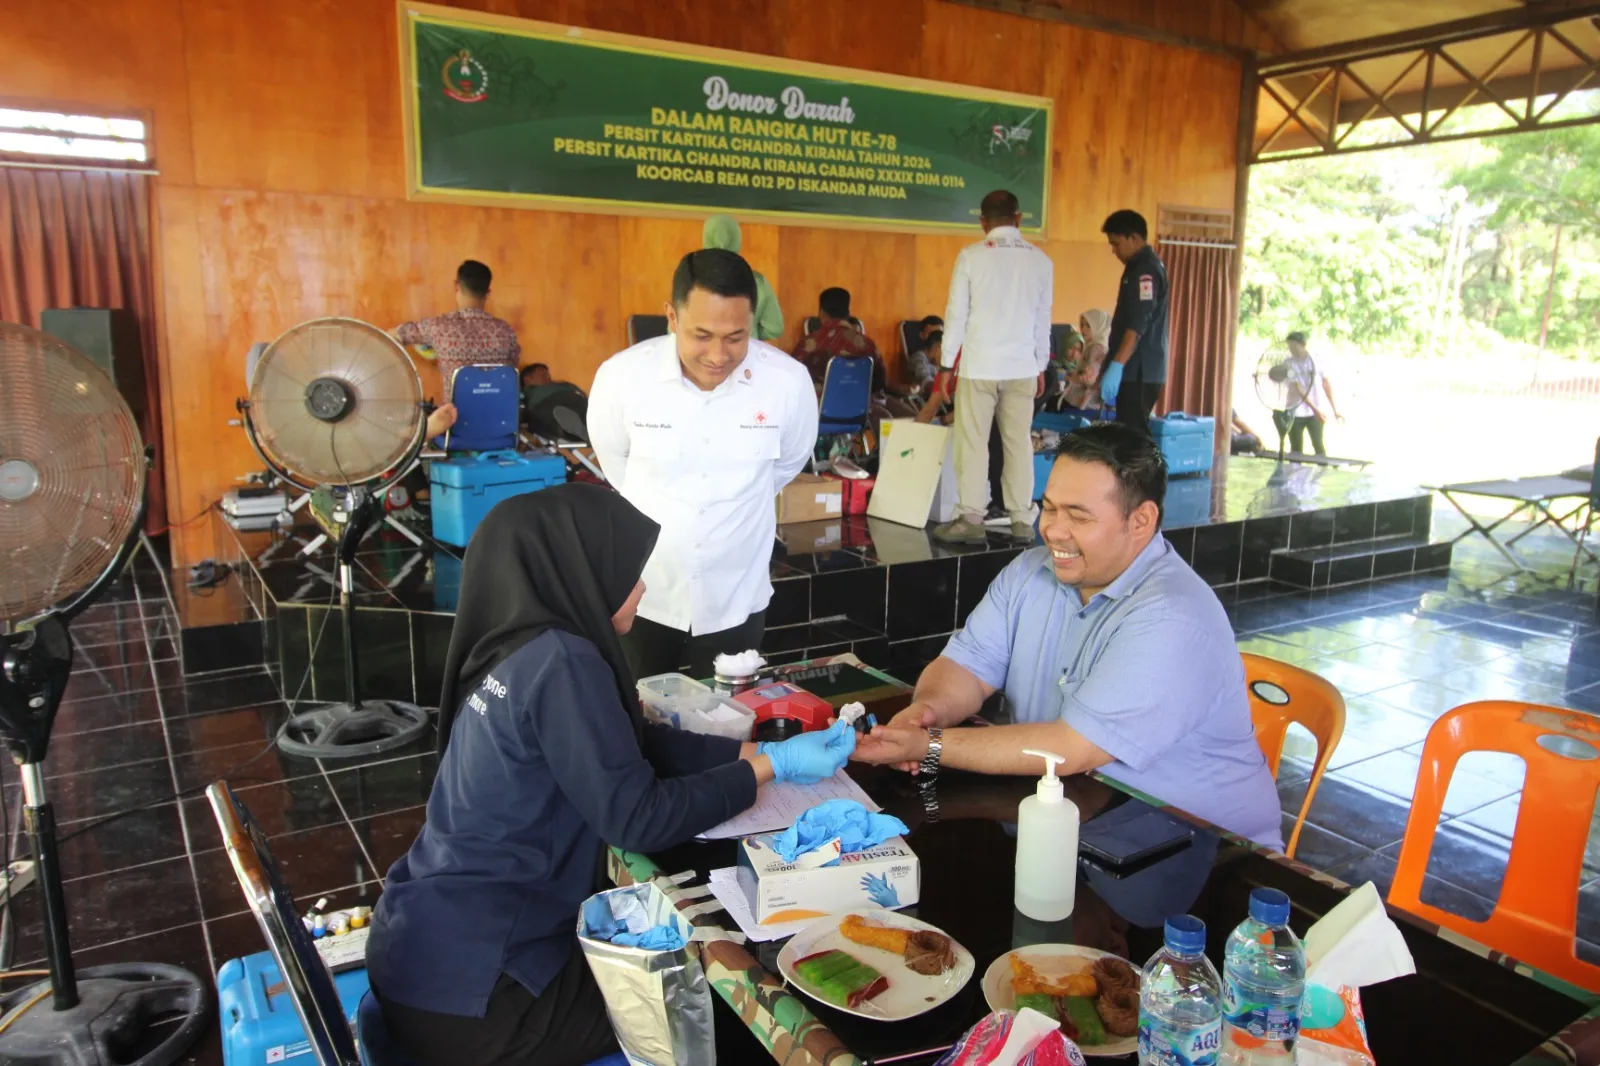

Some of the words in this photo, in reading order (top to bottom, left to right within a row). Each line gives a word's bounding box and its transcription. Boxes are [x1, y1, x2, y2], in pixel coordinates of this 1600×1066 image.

[703, 76, 777, 114] Donor
[781, 86, 855, 123] Darah
[604, 124, 659, 142] PERSIT
[662, 131, 728, 149] KARTIKA
[731, 137, 802, 158] CHANDRA
[805, 145, 855, 162] KIRANA
[858, 151, 901, 166] TAHUN
[903, 156, 932, 169] 2024
[652, 107, 724, 132] DALAM
[729, 116, 808, 141] RANGKA
[812, 126, 849, 144] HUT
[851, 130, 896, 150] KE-78
[554, 137, 612, 157] PERSIT
[614, 143, 684, 163] KARTIKA
[686, 151, 761, 170] CHANDRA
[764, 159, 817, 175] KIRANA
[818, 163, 875, 181] CABANG
[877, 169, 913, 184] XXXIX
[916, 172, 940, 186] DIM
[942, 175, 965, 188] 0114
[636, 164, 714, 184] KOORCAB
[717, 171, 749, 187] REM
[752, 174, 774, 189] 012
[777, 177, 796, 191] PD
[798, 178, 866, 196] ISKANDAR
[868, 186, 907, 199] MUDA
